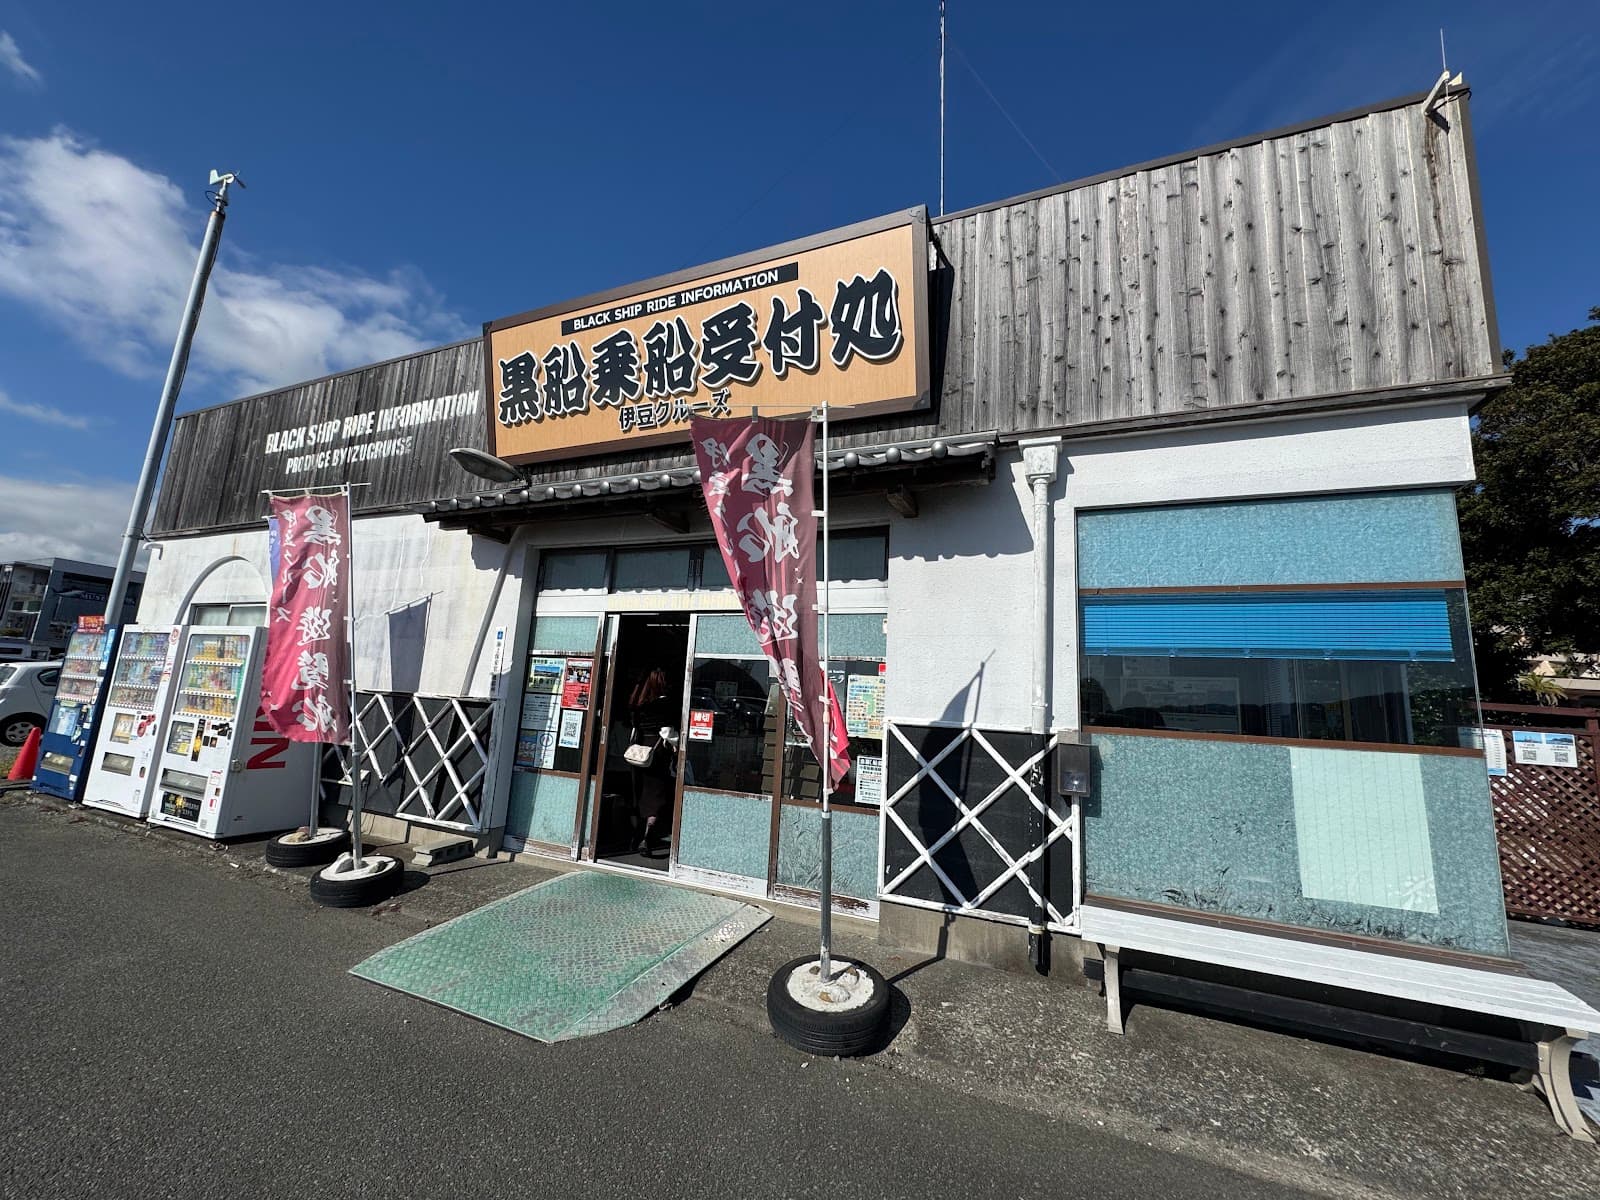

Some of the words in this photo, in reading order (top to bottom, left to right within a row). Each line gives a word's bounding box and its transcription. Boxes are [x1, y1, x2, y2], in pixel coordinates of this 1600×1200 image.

[573, 313, 610, 331] BLACK
[614, 304, 643, 322] SHIP
[647, 296, 677, 315] RIDE
[680, 269, 779, 306] INFORMATION
[498, 267, 904, 427] 黒船乗船受付処
[265, 427, 307, 454] BLACK
[307, 419, 341, 446] SHIP
[342, 411, 376, 439] RIDE
[376, 390, 480, 433] INFORMATION
[619, 388, 731, 431] 伊豆クルーズ
[285, 448, 331, 475] PRODUCE
[332, 447, 348, 465] BY
